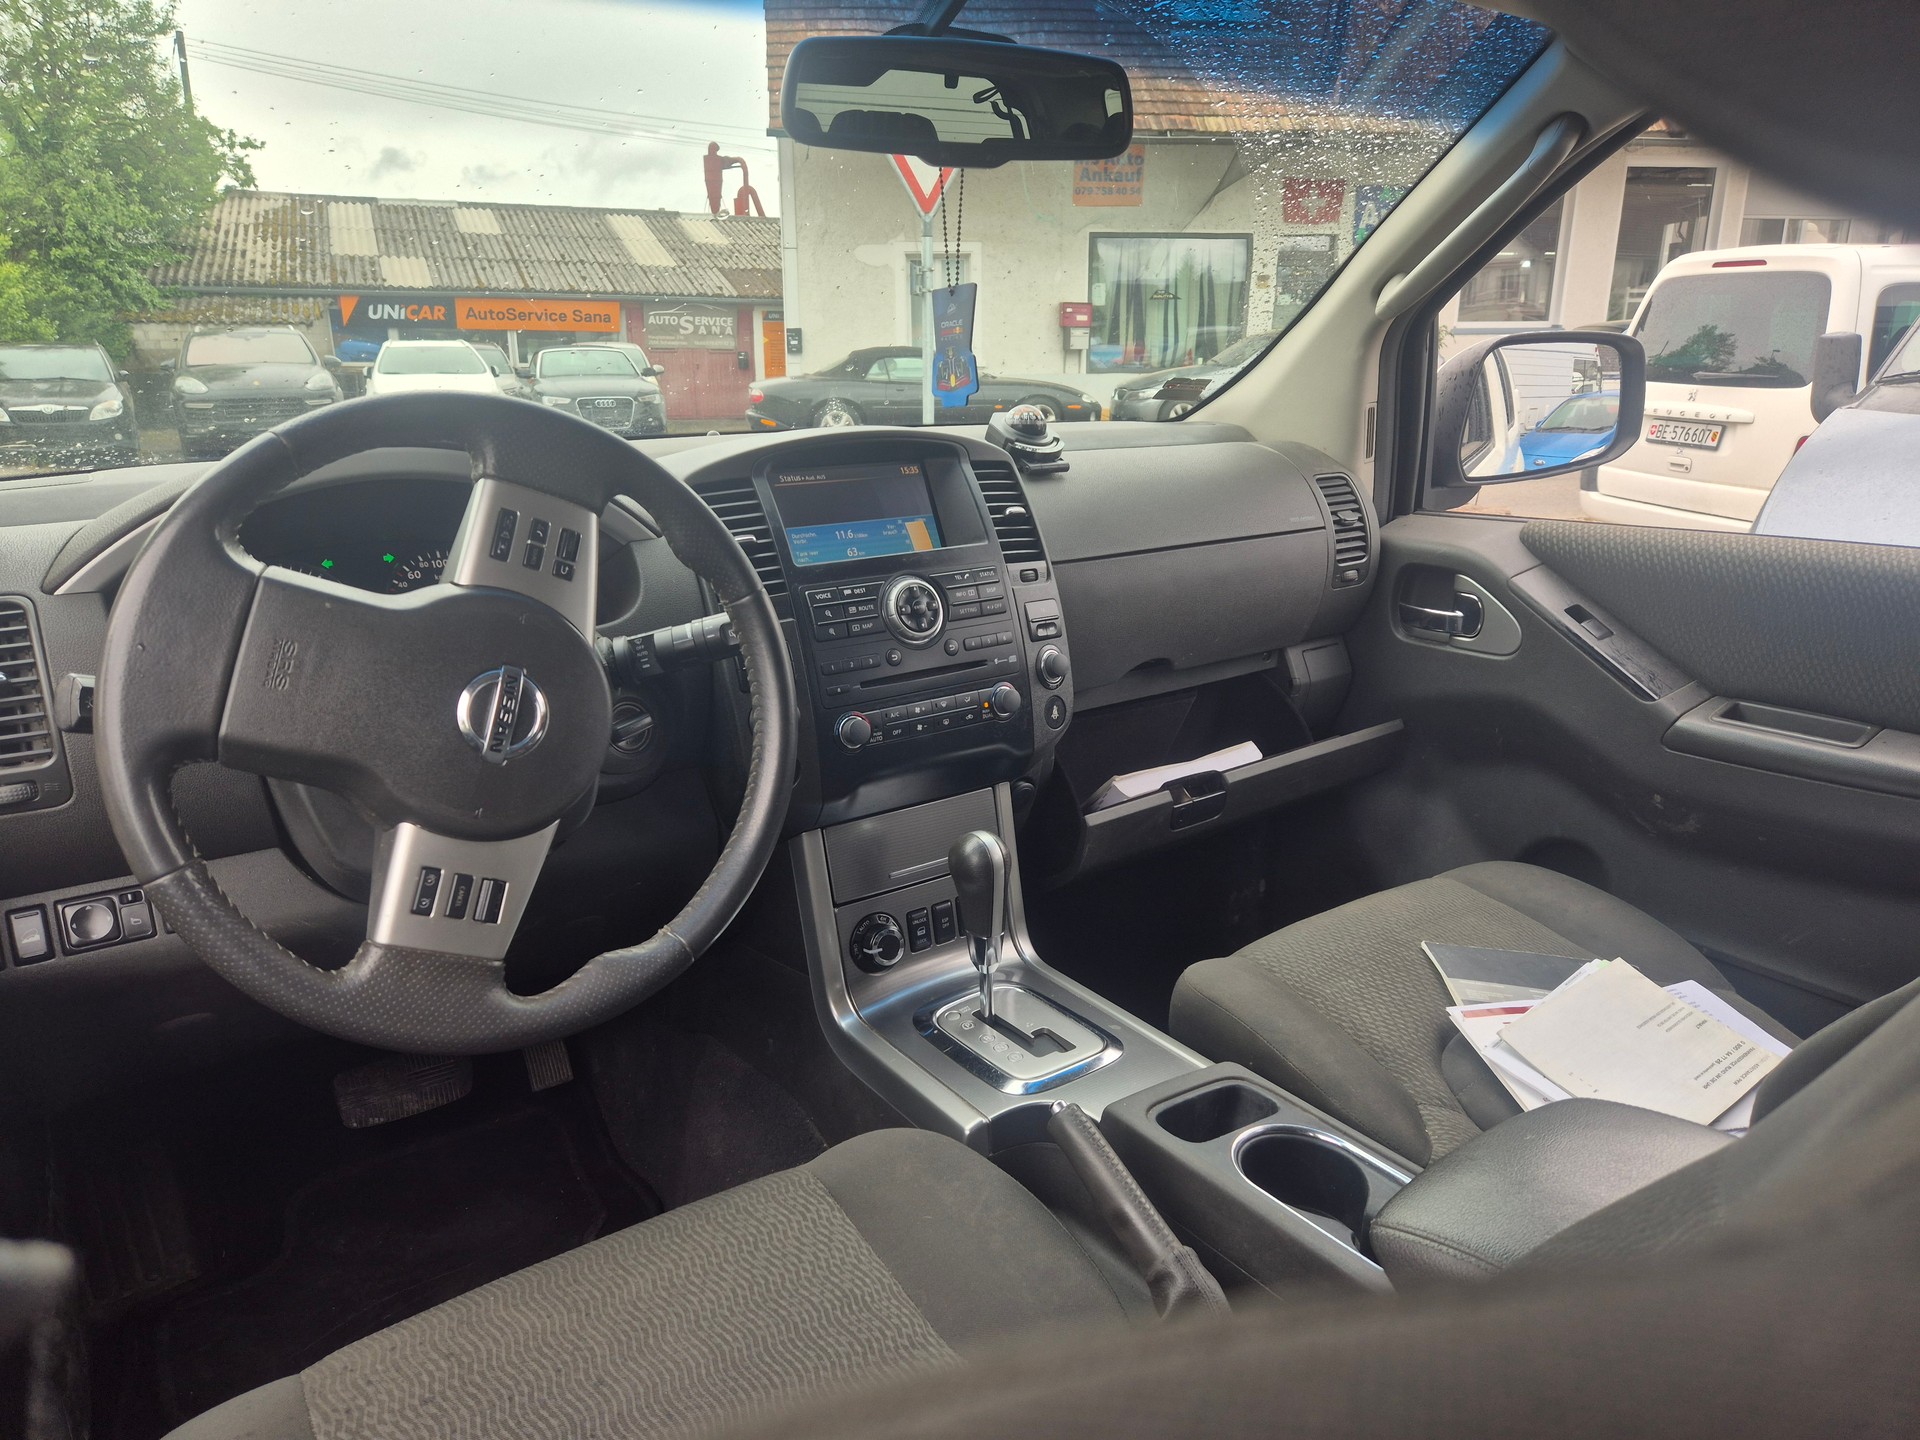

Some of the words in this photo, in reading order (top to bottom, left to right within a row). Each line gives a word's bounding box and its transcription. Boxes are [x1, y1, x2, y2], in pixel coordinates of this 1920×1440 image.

[1080, 167, 1143, 182] Ankauf
[466, 307, 567, 323] AutoService
[572, 309, 612, 324] Sana
[698, 326, 733, 335] SANA
[1644, 407, 1732, 420] EUGEOT
[901, 466, 920, 475] 15:35
[779, 475, 801, 483] Status
[847, 548, 858, 557] 63
[408, 570, 421, 580] 60
[275, 640, 298, 691] SRS
[493, 671, 518, 753] NISSAN
[870, 736, 883, 744] AUTO
